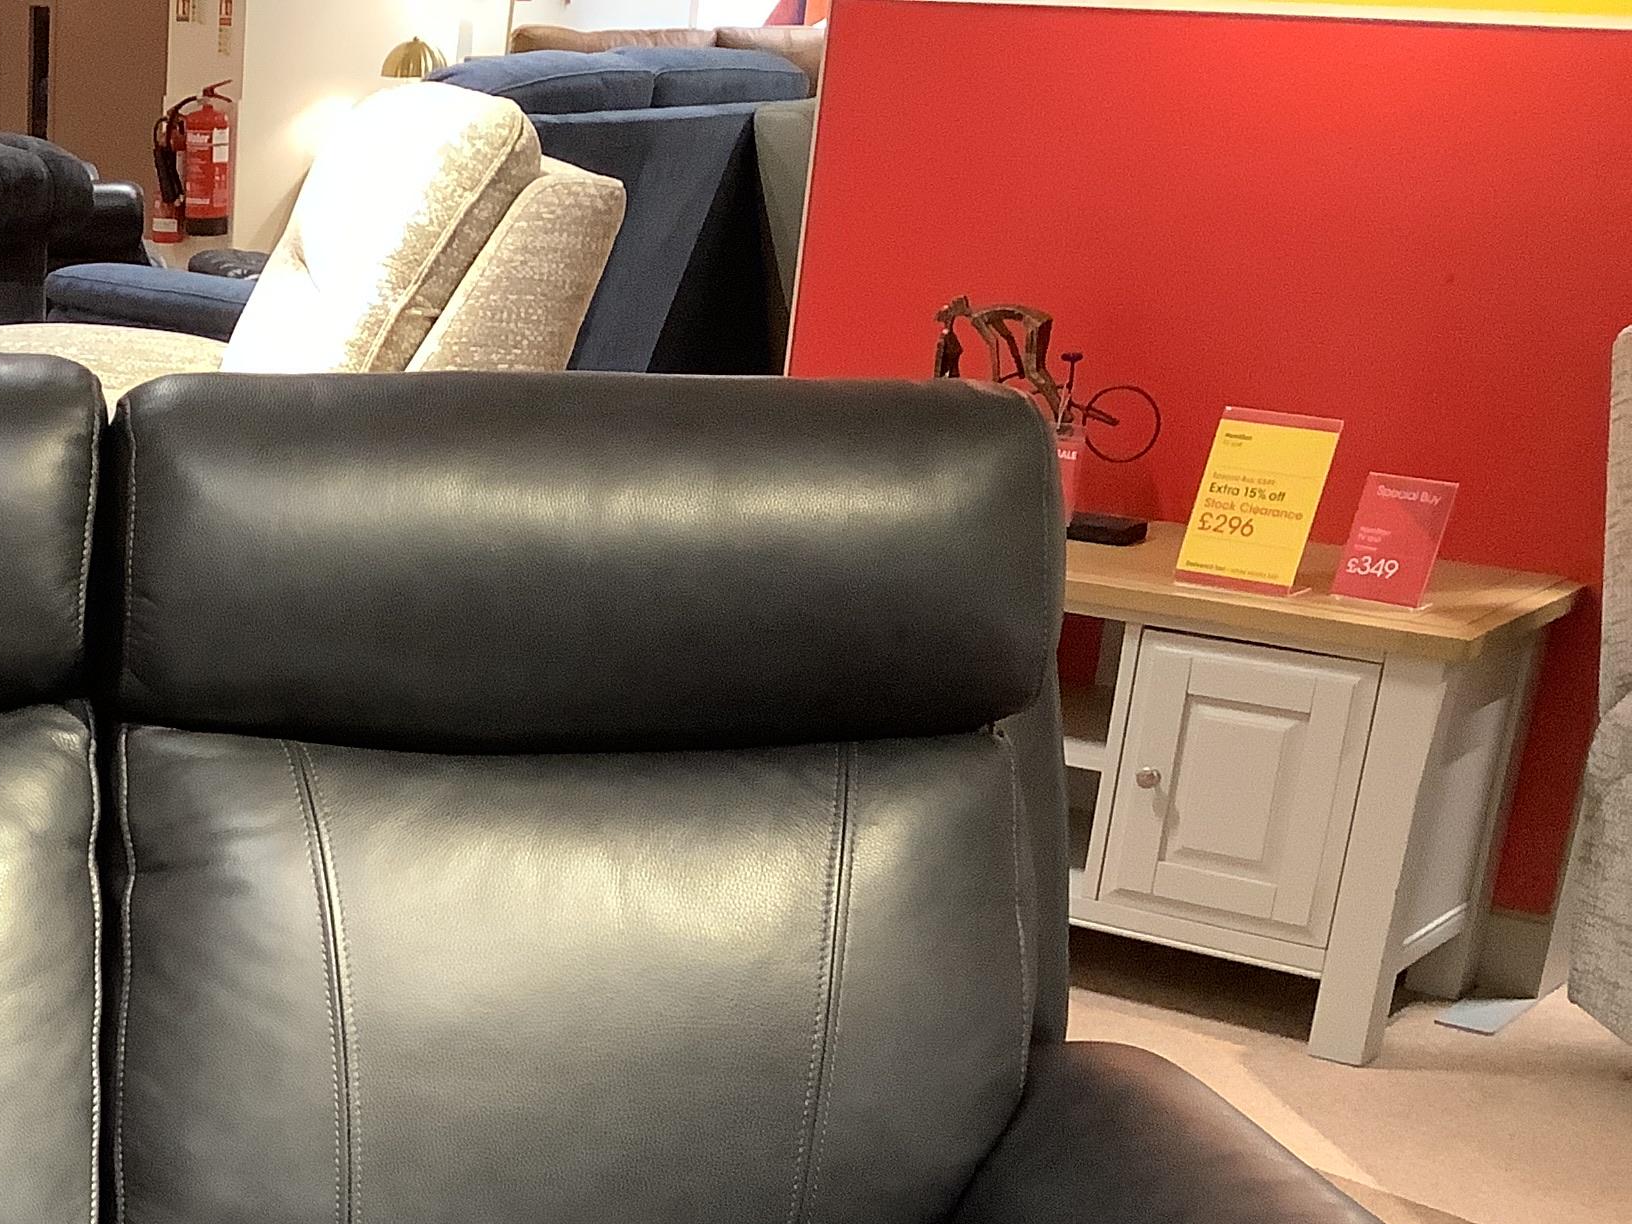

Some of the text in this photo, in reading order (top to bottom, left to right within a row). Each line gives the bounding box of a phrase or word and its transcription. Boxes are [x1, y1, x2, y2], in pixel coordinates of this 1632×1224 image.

[1208, 482, 1286, 503] Extra 15% off
[1420, 491, 1442, 506] Buy
[1204, 497, 1304, 521] Stock Clearance
[1197, 511, 1255, 538] £296
[1346, 555, 1400, 579] £349
